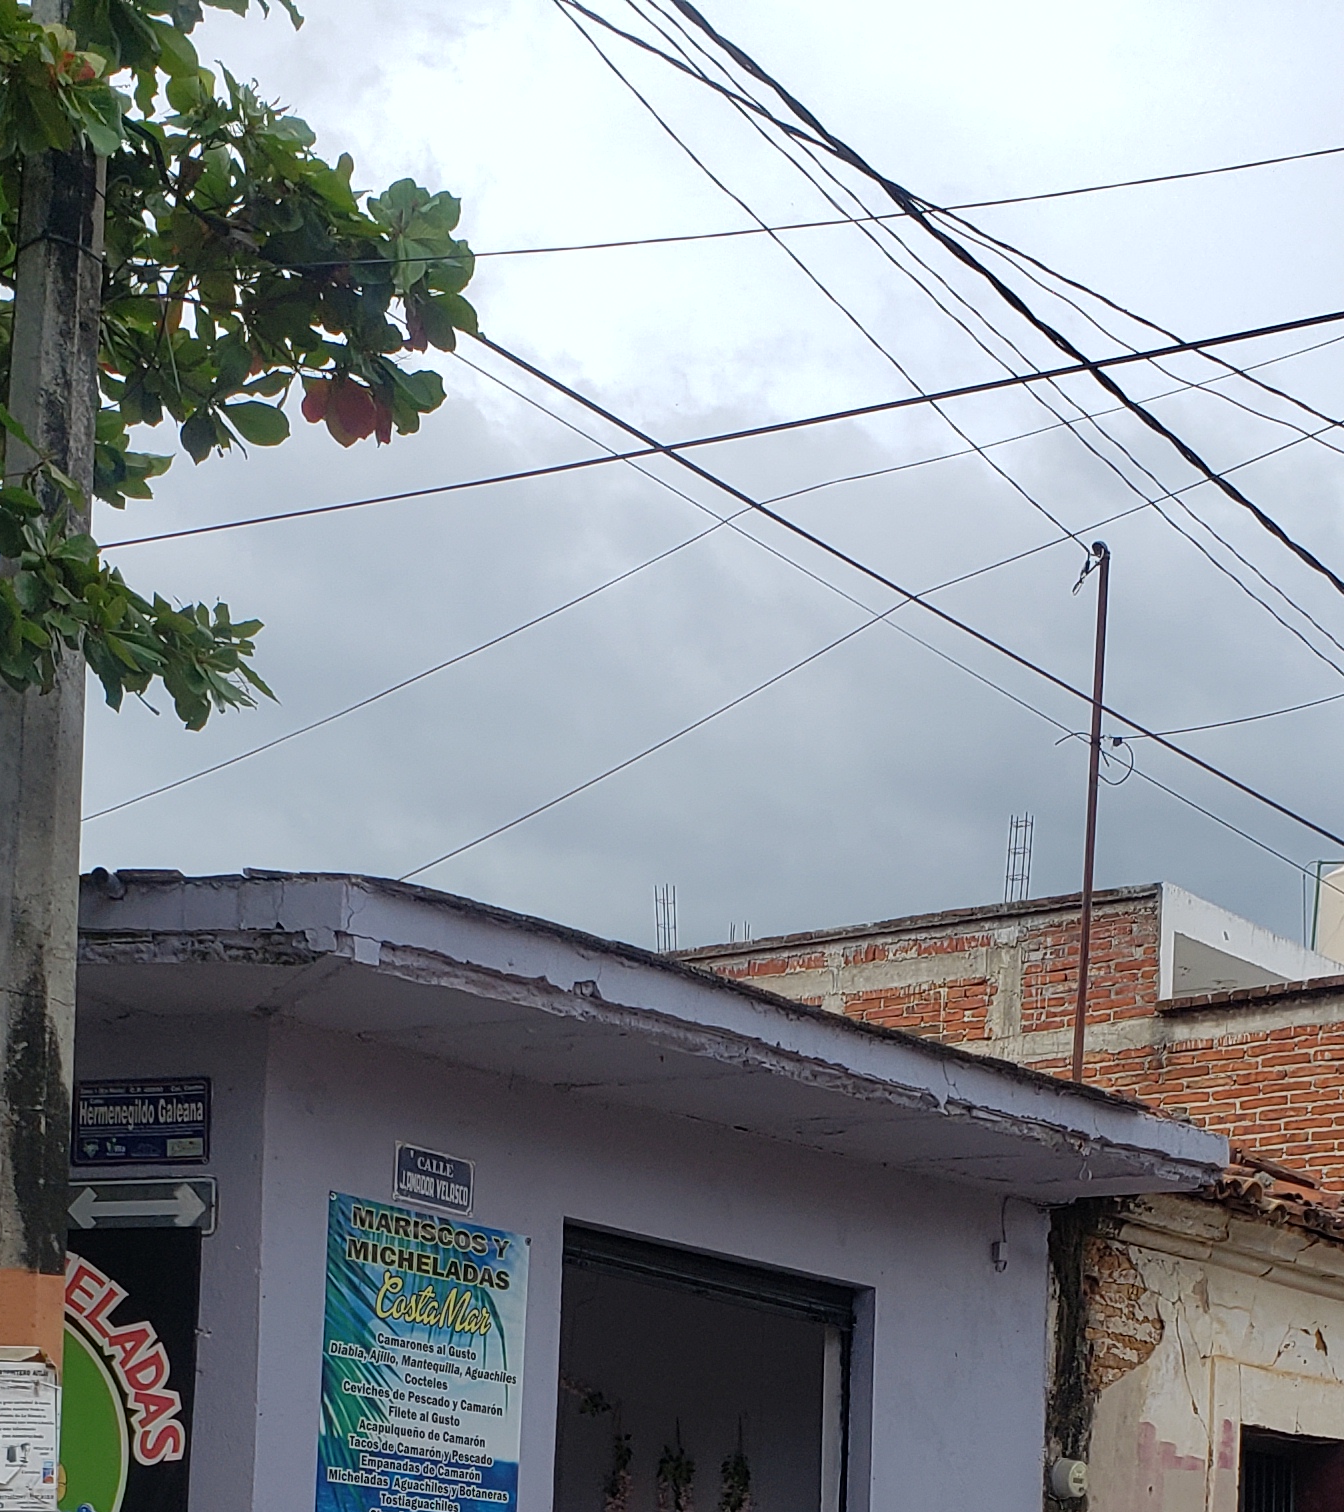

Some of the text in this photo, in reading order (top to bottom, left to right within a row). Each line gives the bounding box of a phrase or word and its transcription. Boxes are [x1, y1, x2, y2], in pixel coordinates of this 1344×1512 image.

[79, 1097, 204, 1131] Hermenegildo Galeana
[417, 1156, 454, 1178] CALLE
[436, 1179, 469, 1206] VELASCO
[352, 1205, 511, 1259] MARISCOS Y
[347, 1238, 510, 1290] MICHELADAS
[377, 1333, 476, 1361] Camarones al Gusto
[330, 1342, 368, 1361] Diabla,
[401, 1354, 463, 1378] Mantequilla,
[465, 1368, 517, 1385] Aguachiles
[405, 1373, 448, 1391] Cocteles
[343, 1380, 503, 1416] Ceviches de Pescado y Camarón
[388, 1405, 460, 1427] Filete al Gusto
[359, 1418, 486, 1448] Acapulqueño de Camarón
[349, 1435, 493, 1466] Tacos de Camarón y Pescado
[361, 1455, 481, 1482] Empanadas de Camarón
[328, 1469, 508, 1502] Micheladas Aguachiles y Botaneras
[380, 1493, 459, 1512] Tostiaguachiles
